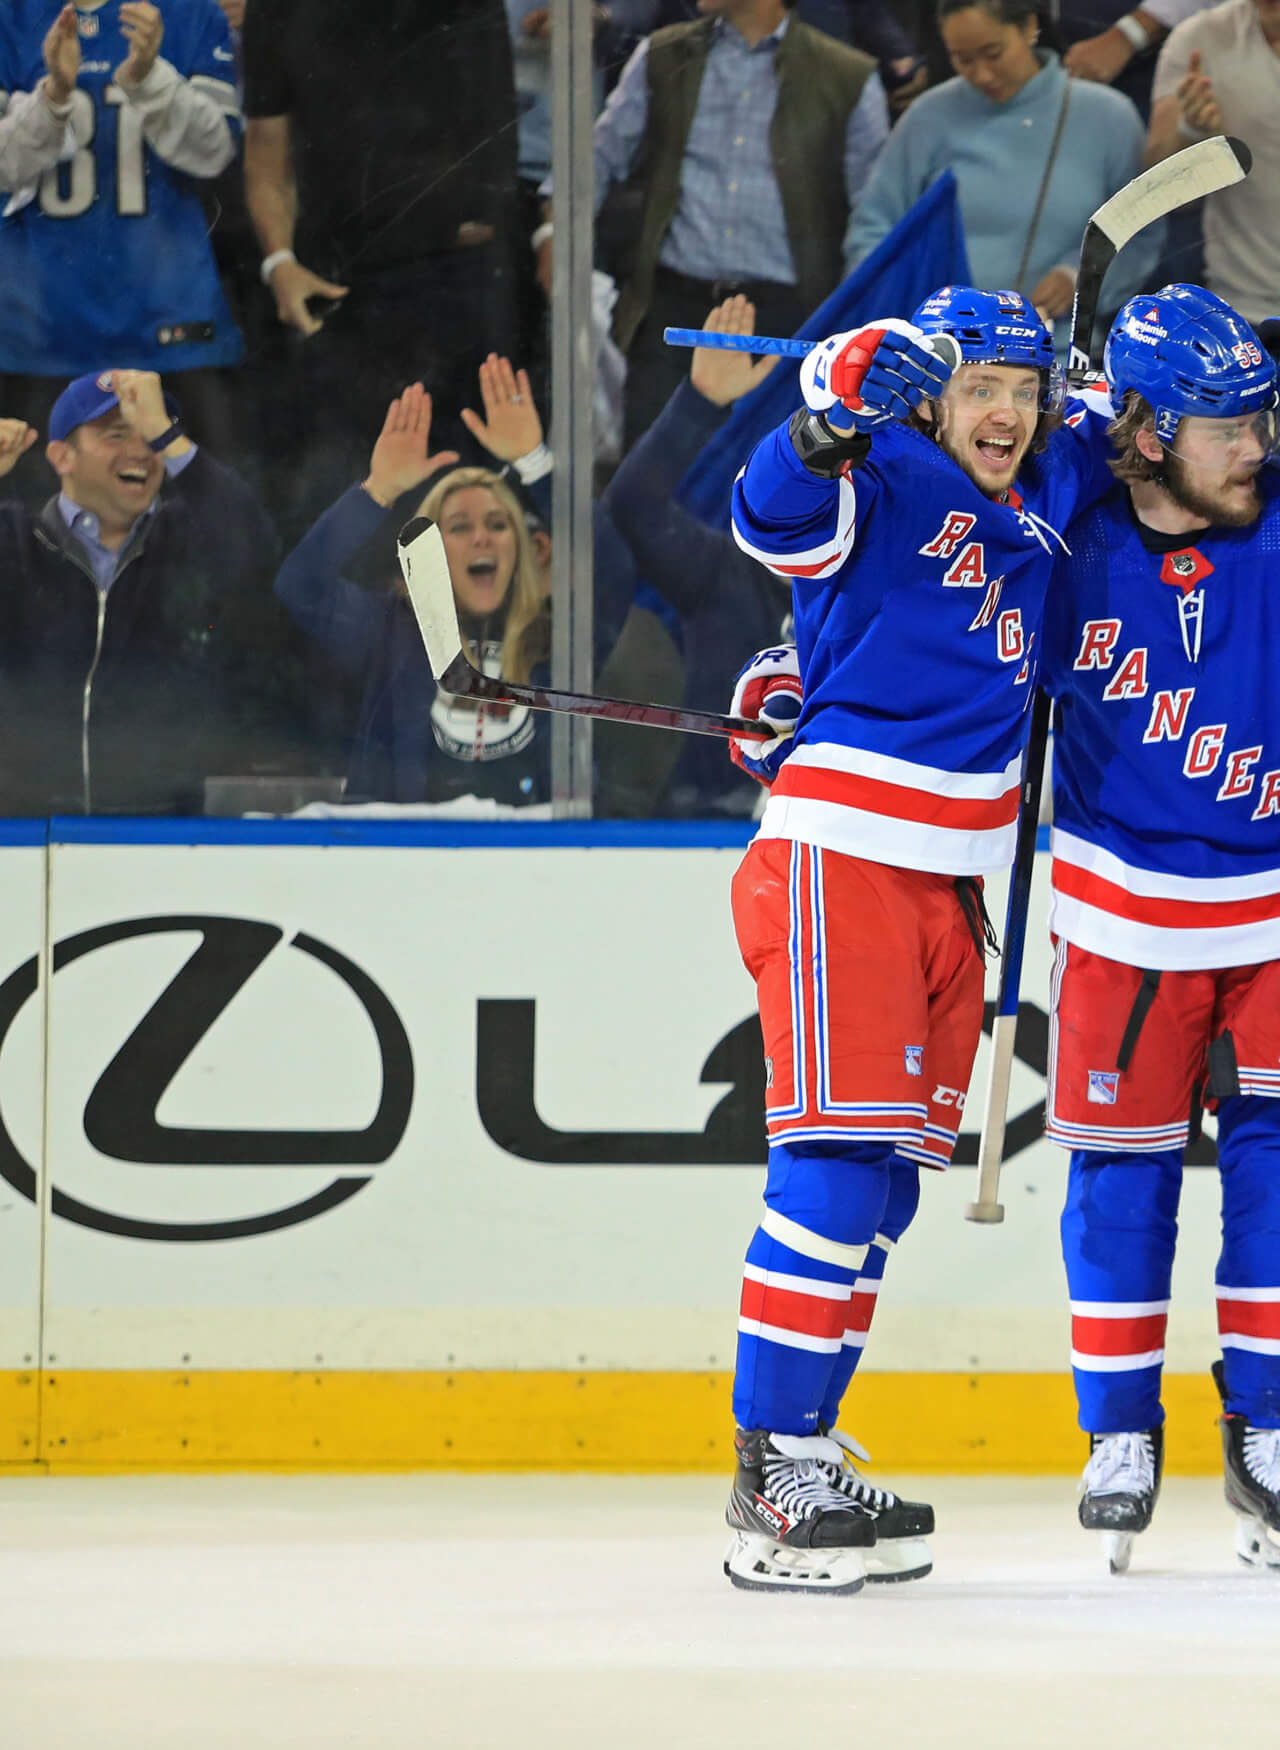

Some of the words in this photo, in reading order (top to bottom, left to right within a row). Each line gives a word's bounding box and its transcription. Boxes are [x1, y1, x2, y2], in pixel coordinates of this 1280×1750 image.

[995, 325, 1037, 338] CCM
[1231, 341, 1262, 369] 55
[755, 1502, 783, 1529] CCM
